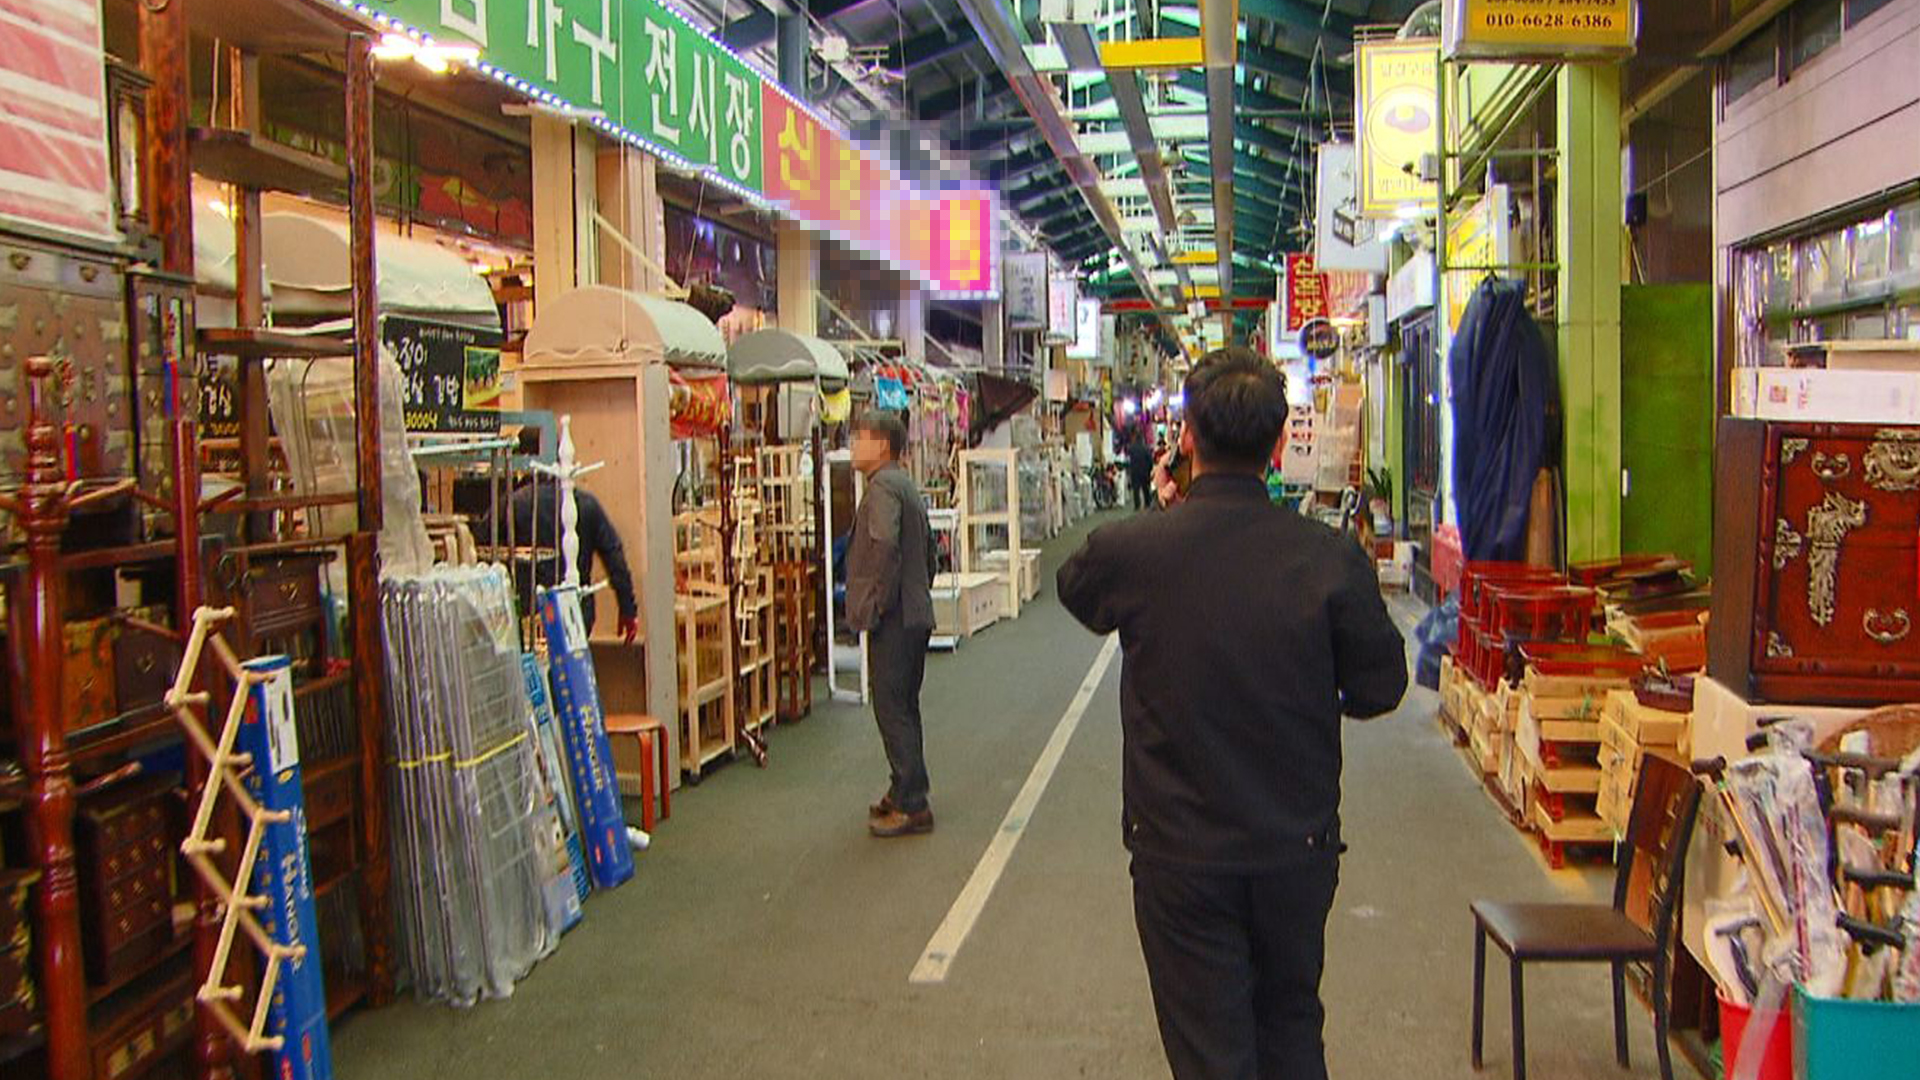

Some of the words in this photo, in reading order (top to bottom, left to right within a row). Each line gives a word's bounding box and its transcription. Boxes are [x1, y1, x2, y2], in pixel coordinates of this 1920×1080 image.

[1486, 13, 1612, 28] 010-6628-6386
[644, 21, 753, 180] 전시장
[580, 703, 604, 794] HANGER
